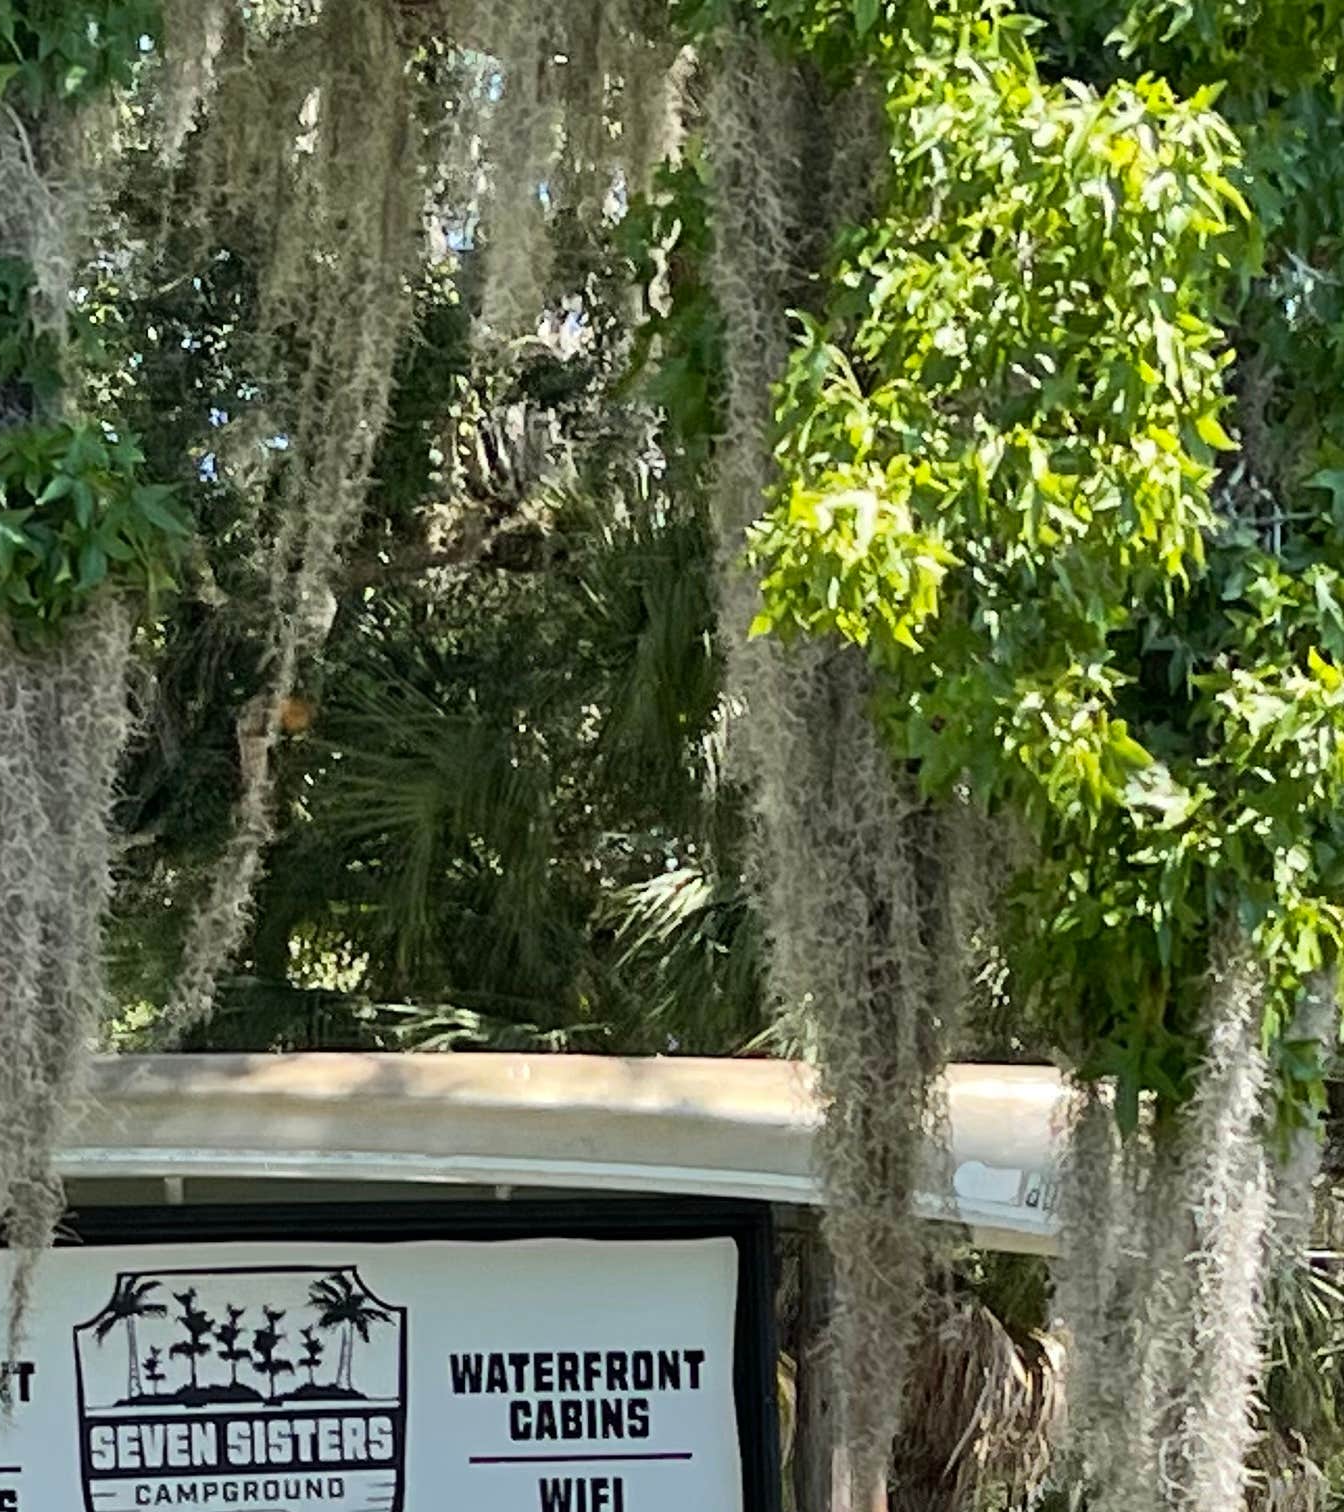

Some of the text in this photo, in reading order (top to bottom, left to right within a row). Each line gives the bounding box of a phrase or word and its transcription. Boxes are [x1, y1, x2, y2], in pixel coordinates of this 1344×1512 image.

[449, 1349, 705, 1394] WATERFRONT
[509, 1398, 650, 1441] CABINS
[89, 1416, 394, 1470] SEVEN SISTERS
[134, 1476, 346, 1506] CAMPGROUND
